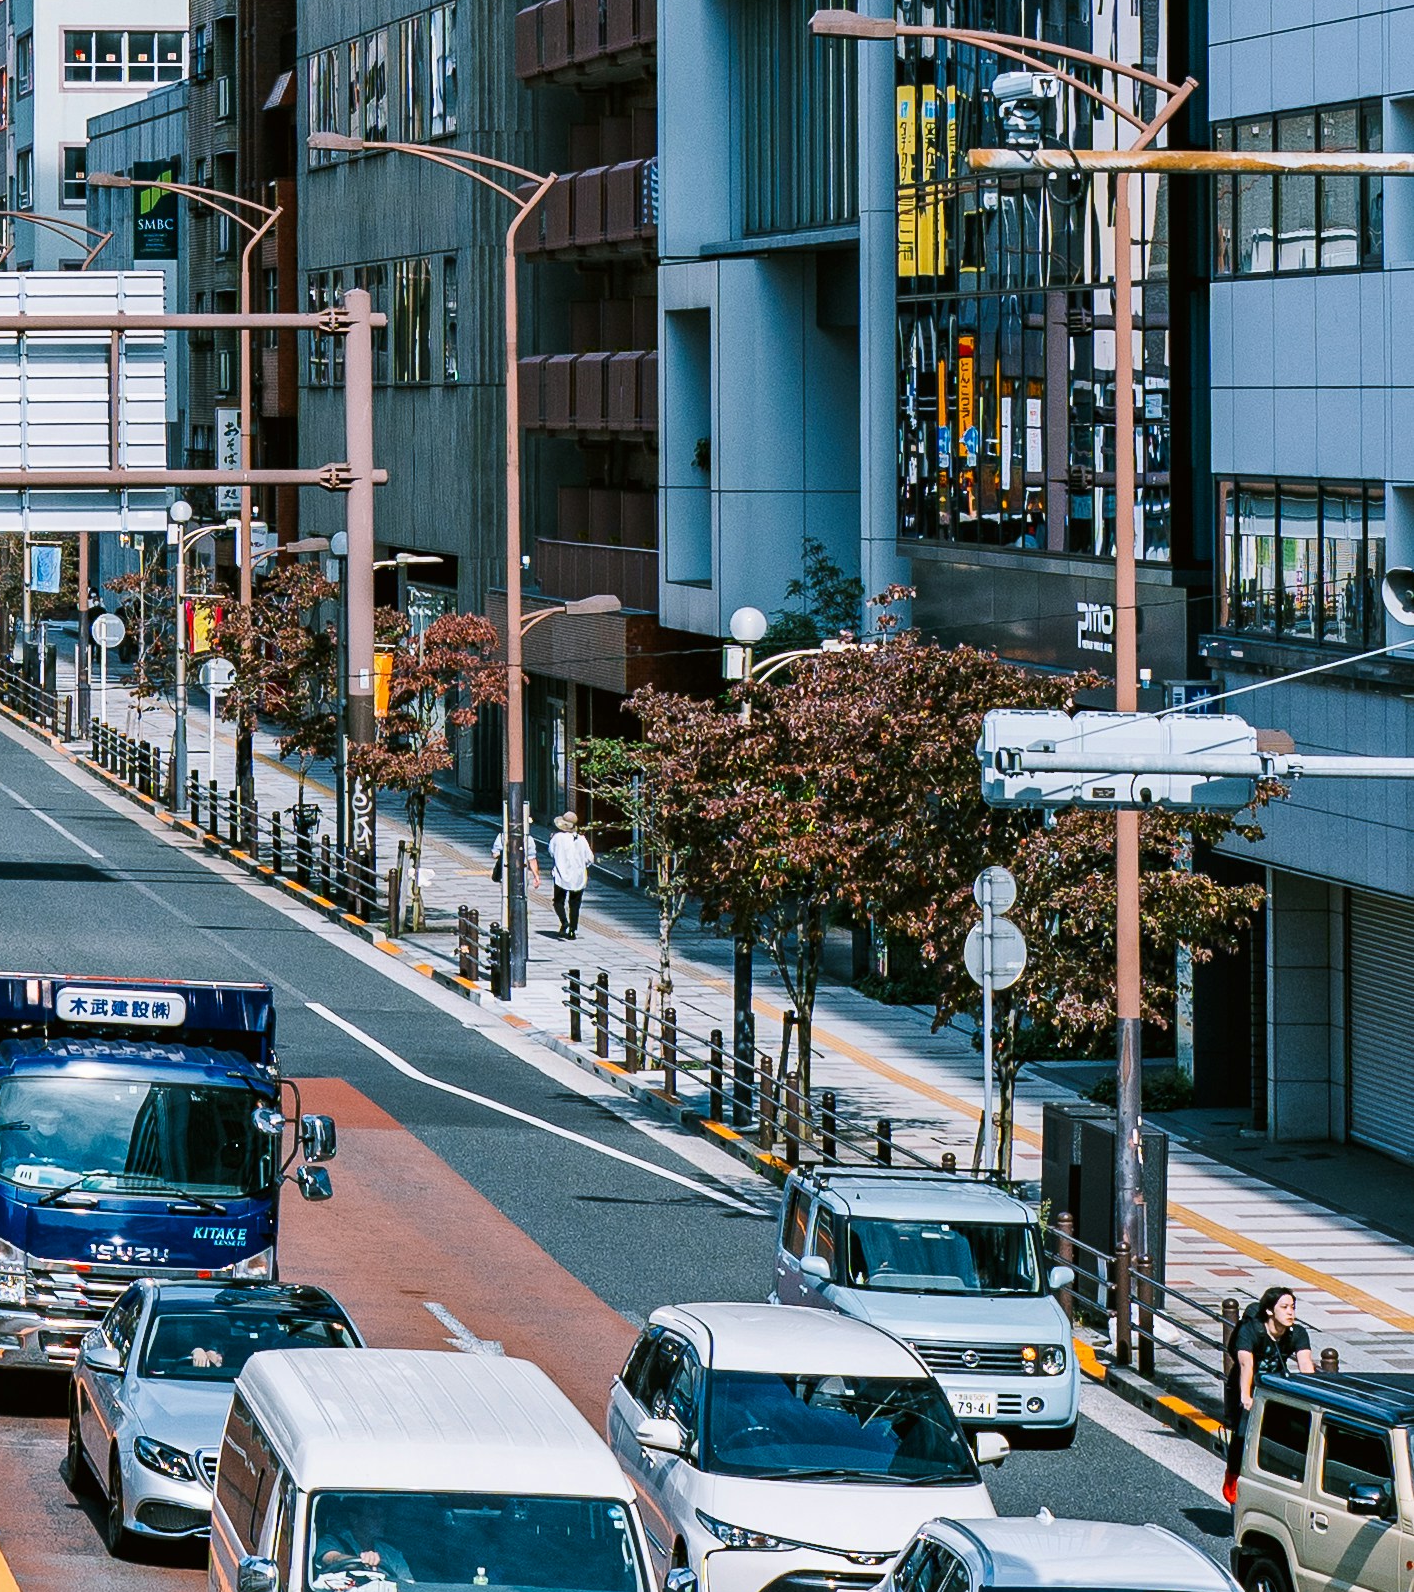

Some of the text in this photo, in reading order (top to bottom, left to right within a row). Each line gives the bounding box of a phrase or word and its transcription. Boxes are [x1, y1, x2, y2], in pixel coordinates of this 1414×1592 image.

[137, 218, 174, 230] SMBC
[193, 1226, 248, 1240] KITAKE
[90, 1243, 170, 1263] ISUZU
[958, 1401, 990, 1414] 79-41
